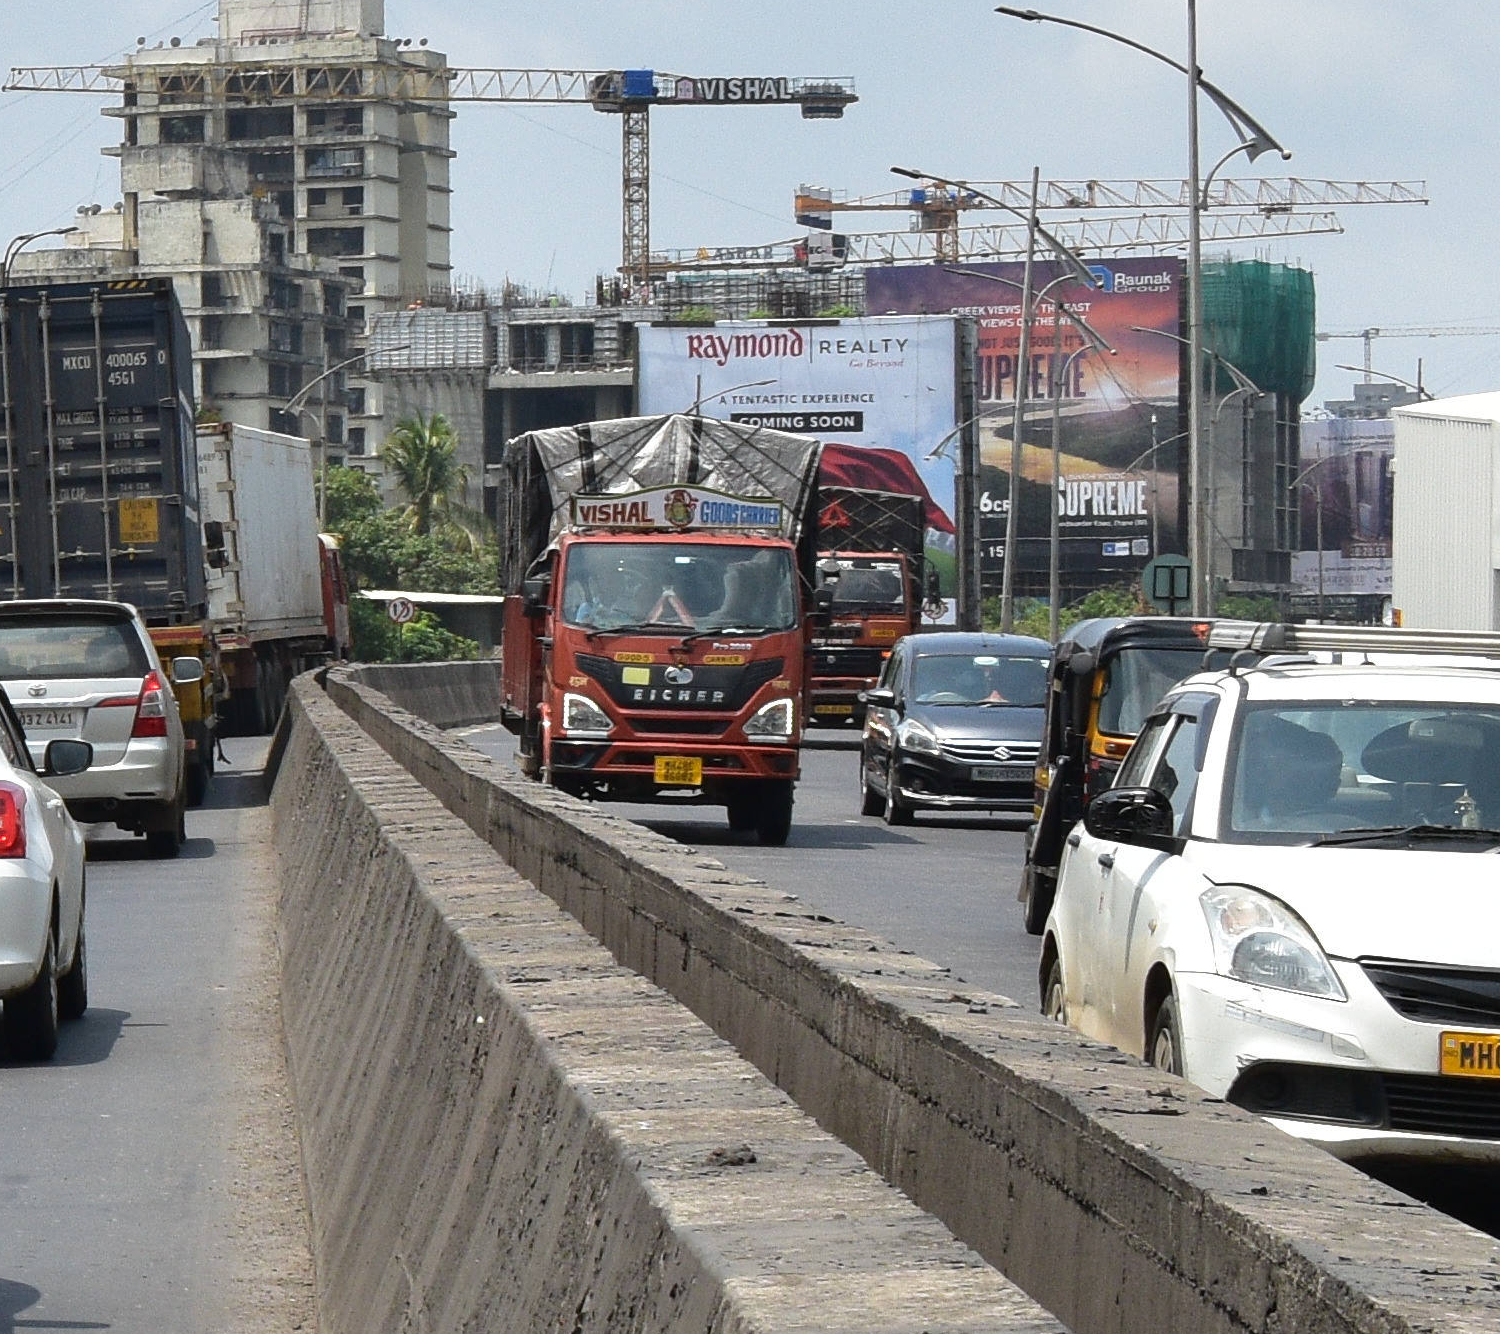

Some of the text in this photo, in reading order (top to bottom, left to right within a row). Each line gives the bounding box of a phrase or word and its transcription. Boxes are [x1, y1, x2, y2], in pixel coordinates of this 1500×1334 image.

[701, 78, 792, 100] VISHAL
[1113, 271, 1172, 286] Raunak
[1113, 285, 1170, 294] Group
[987, 304, 1021, 315] VIEWS
[980, 316, 1014, 328] VIEWS
[686, 327, 909, 366] Raymond REALTY
[62, 349, 166, 371] MXCU 400065 0
[107, 370, 136, 386] 45G1
[718, 394, 875, 405] A TENTASTIC EXPERIENCE
[739, 415, 855, 429] COMING SOON
[579, 501, 655, 524] VISHAL
[702, 501, 738, 524] GOODS
[633, 688, 726, 703] EICHER
[1460, 1041, 1500, 1070] MH
